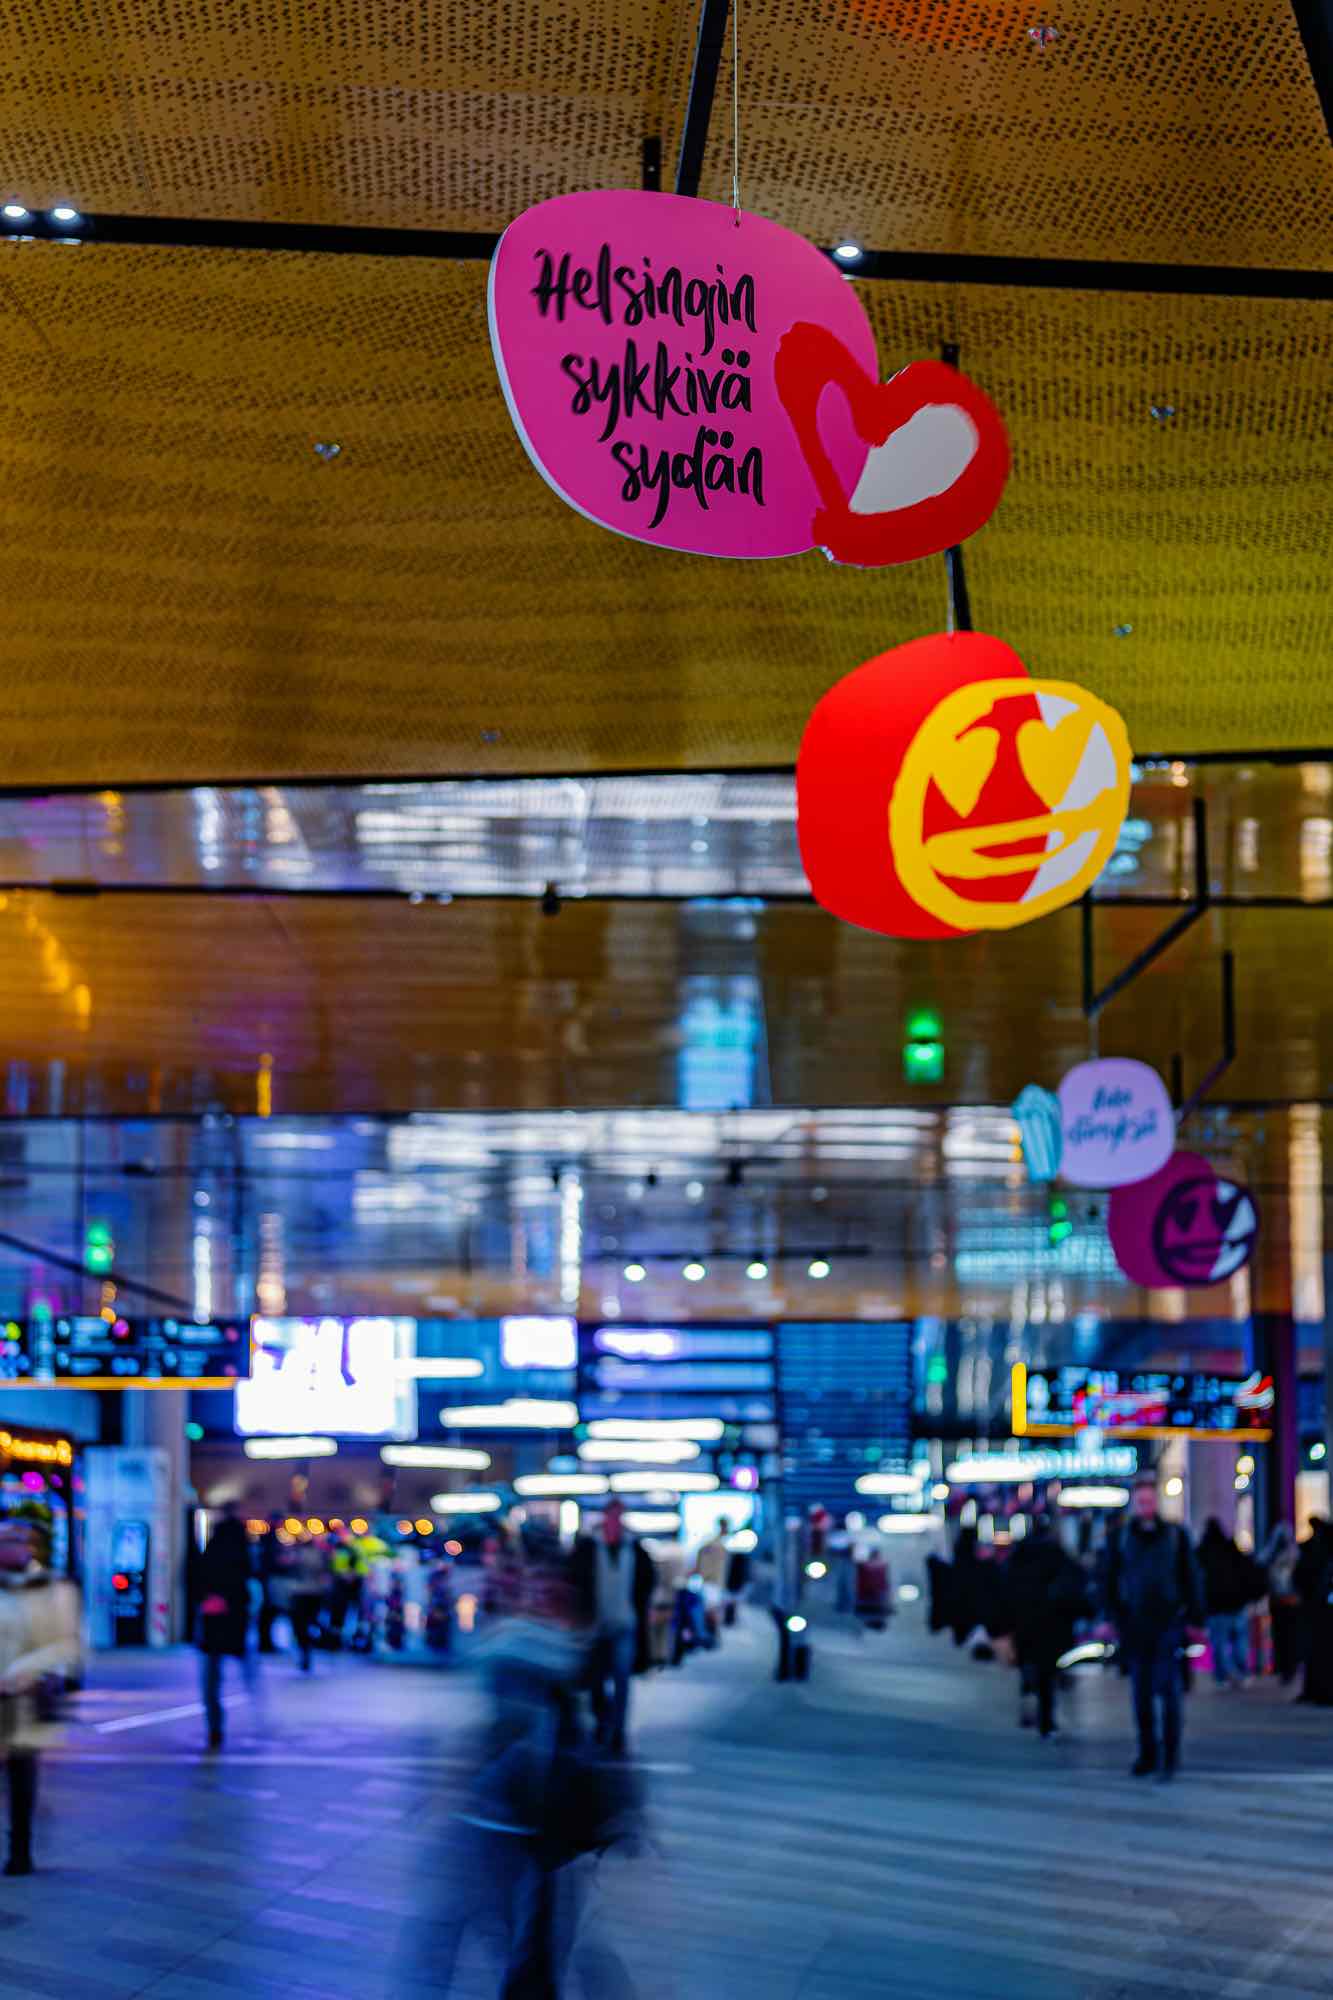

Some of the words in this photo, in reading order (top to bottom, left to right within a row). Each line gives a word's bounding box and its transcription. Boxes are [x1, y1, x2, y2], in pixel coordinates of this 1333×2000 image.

[531, 243, 757, 356] Helsingin
[561, 338, 752, 442] sykkivä
[611, 426, 766, 529] sydän
